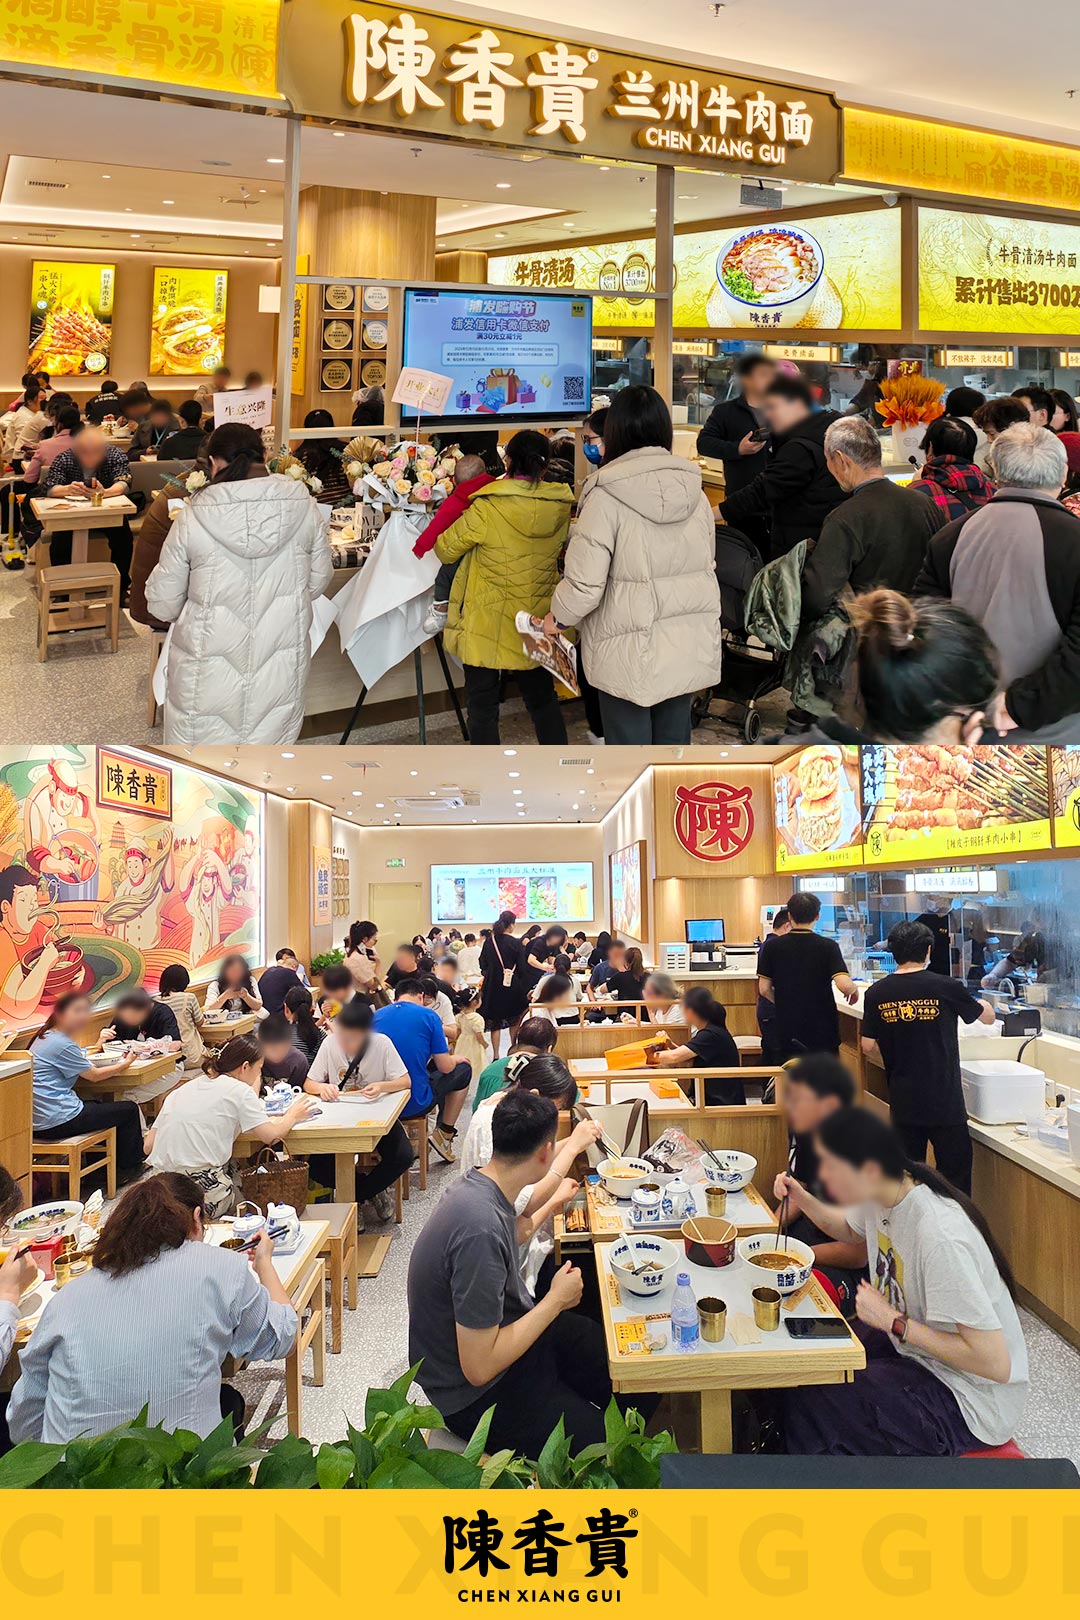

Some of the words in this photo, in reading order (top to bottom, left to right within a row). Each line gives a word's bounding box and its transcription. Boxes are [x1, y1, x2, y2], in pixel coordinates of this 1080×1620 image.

[348, 13, 599, 143] 陳香貴
[612, 69, 814, 146] 兰州牛肉面
[645, 127, 692, 151] CHEN
[698, 134, 753, 159] XIANG
[758, 144, 787, 164] GUI
[514, 256, 575, 287] 牛骨清汤
[998, 244, 1077, 269] 牛骨清汤牛肉面
[451, 316, 551, 333] 浦发信用卡微信支付
[476, 332, 523, 341] 满30元立减1元
[225, 401, 266, 416] 生意兴隆
[106, 763, 158, 806] 陳香貴
[678, 787, 749, 858] 陳
